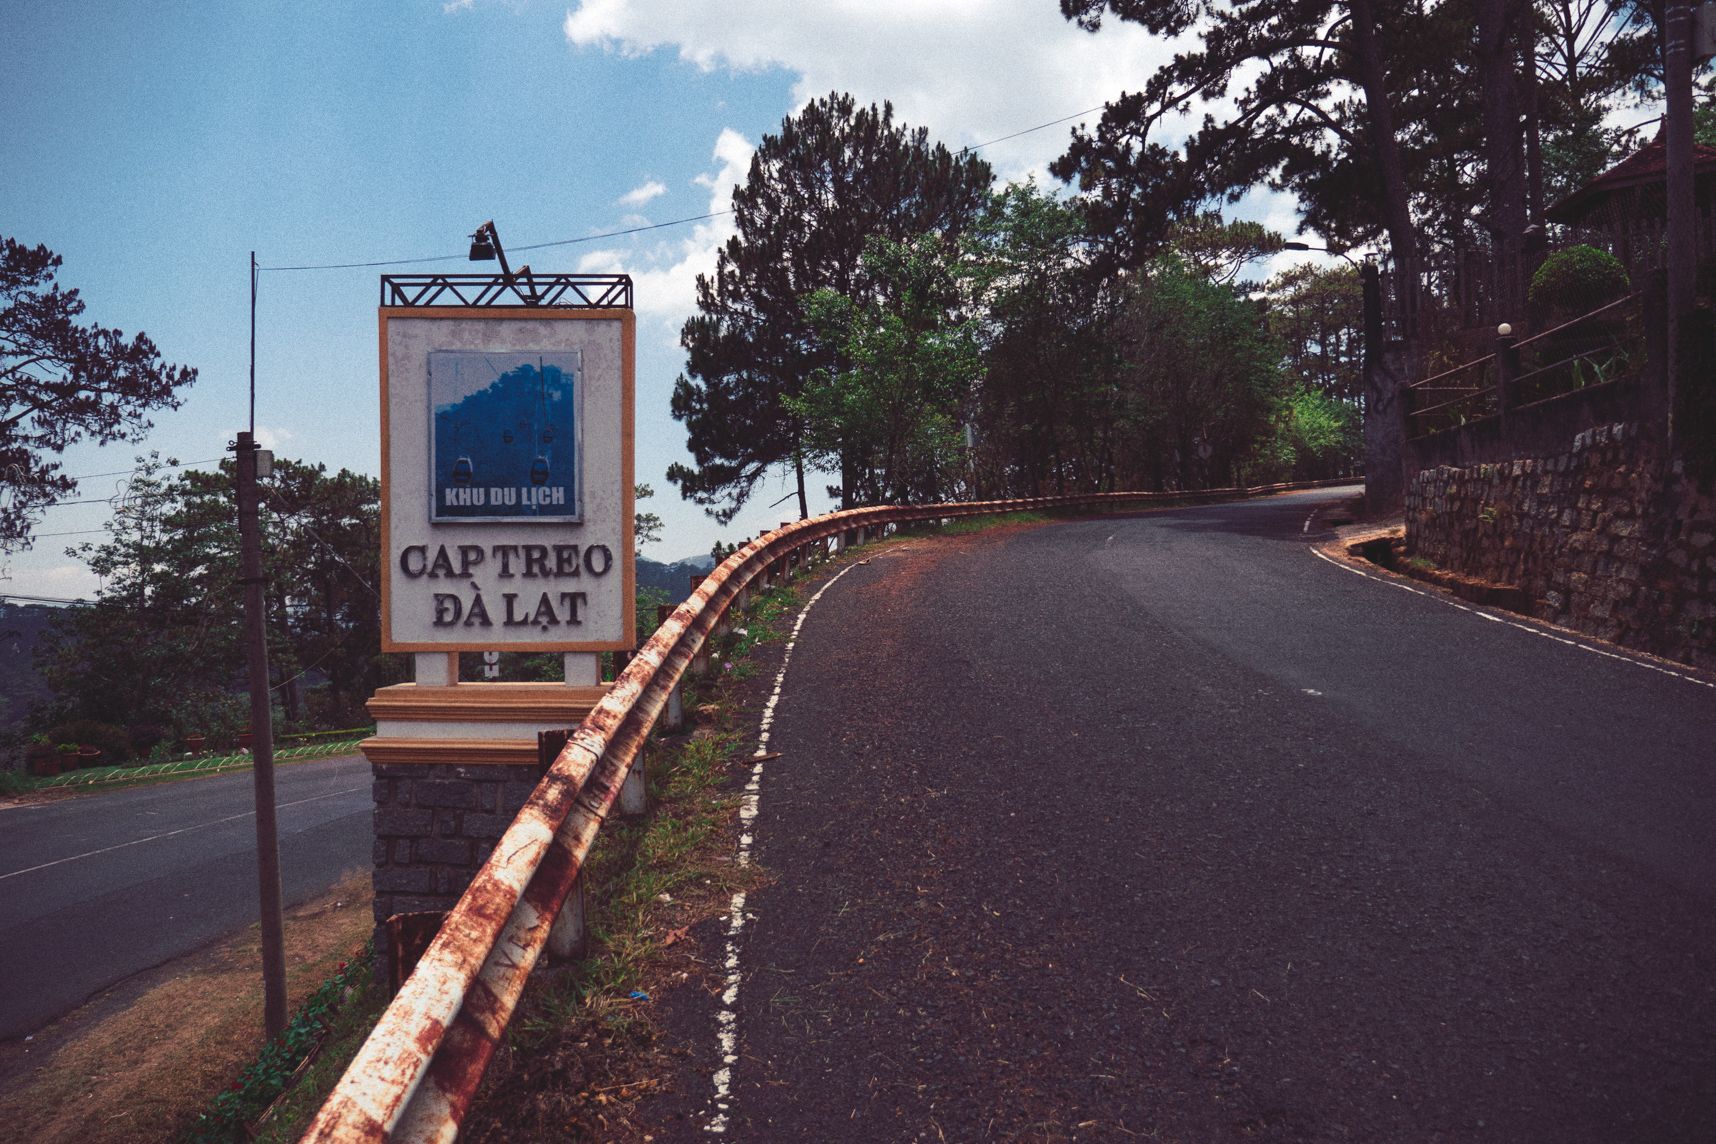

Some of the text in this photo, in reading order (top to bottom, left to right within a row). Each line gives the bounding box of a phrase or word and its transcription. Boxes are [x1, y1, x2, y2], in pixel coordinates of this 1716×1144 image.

[445, 486, 565, 510] KHU DU LỊCH
[400, 543, 613, 578] CAP TREO
[432, 581, 588, 632] ĐÀ LẠT
